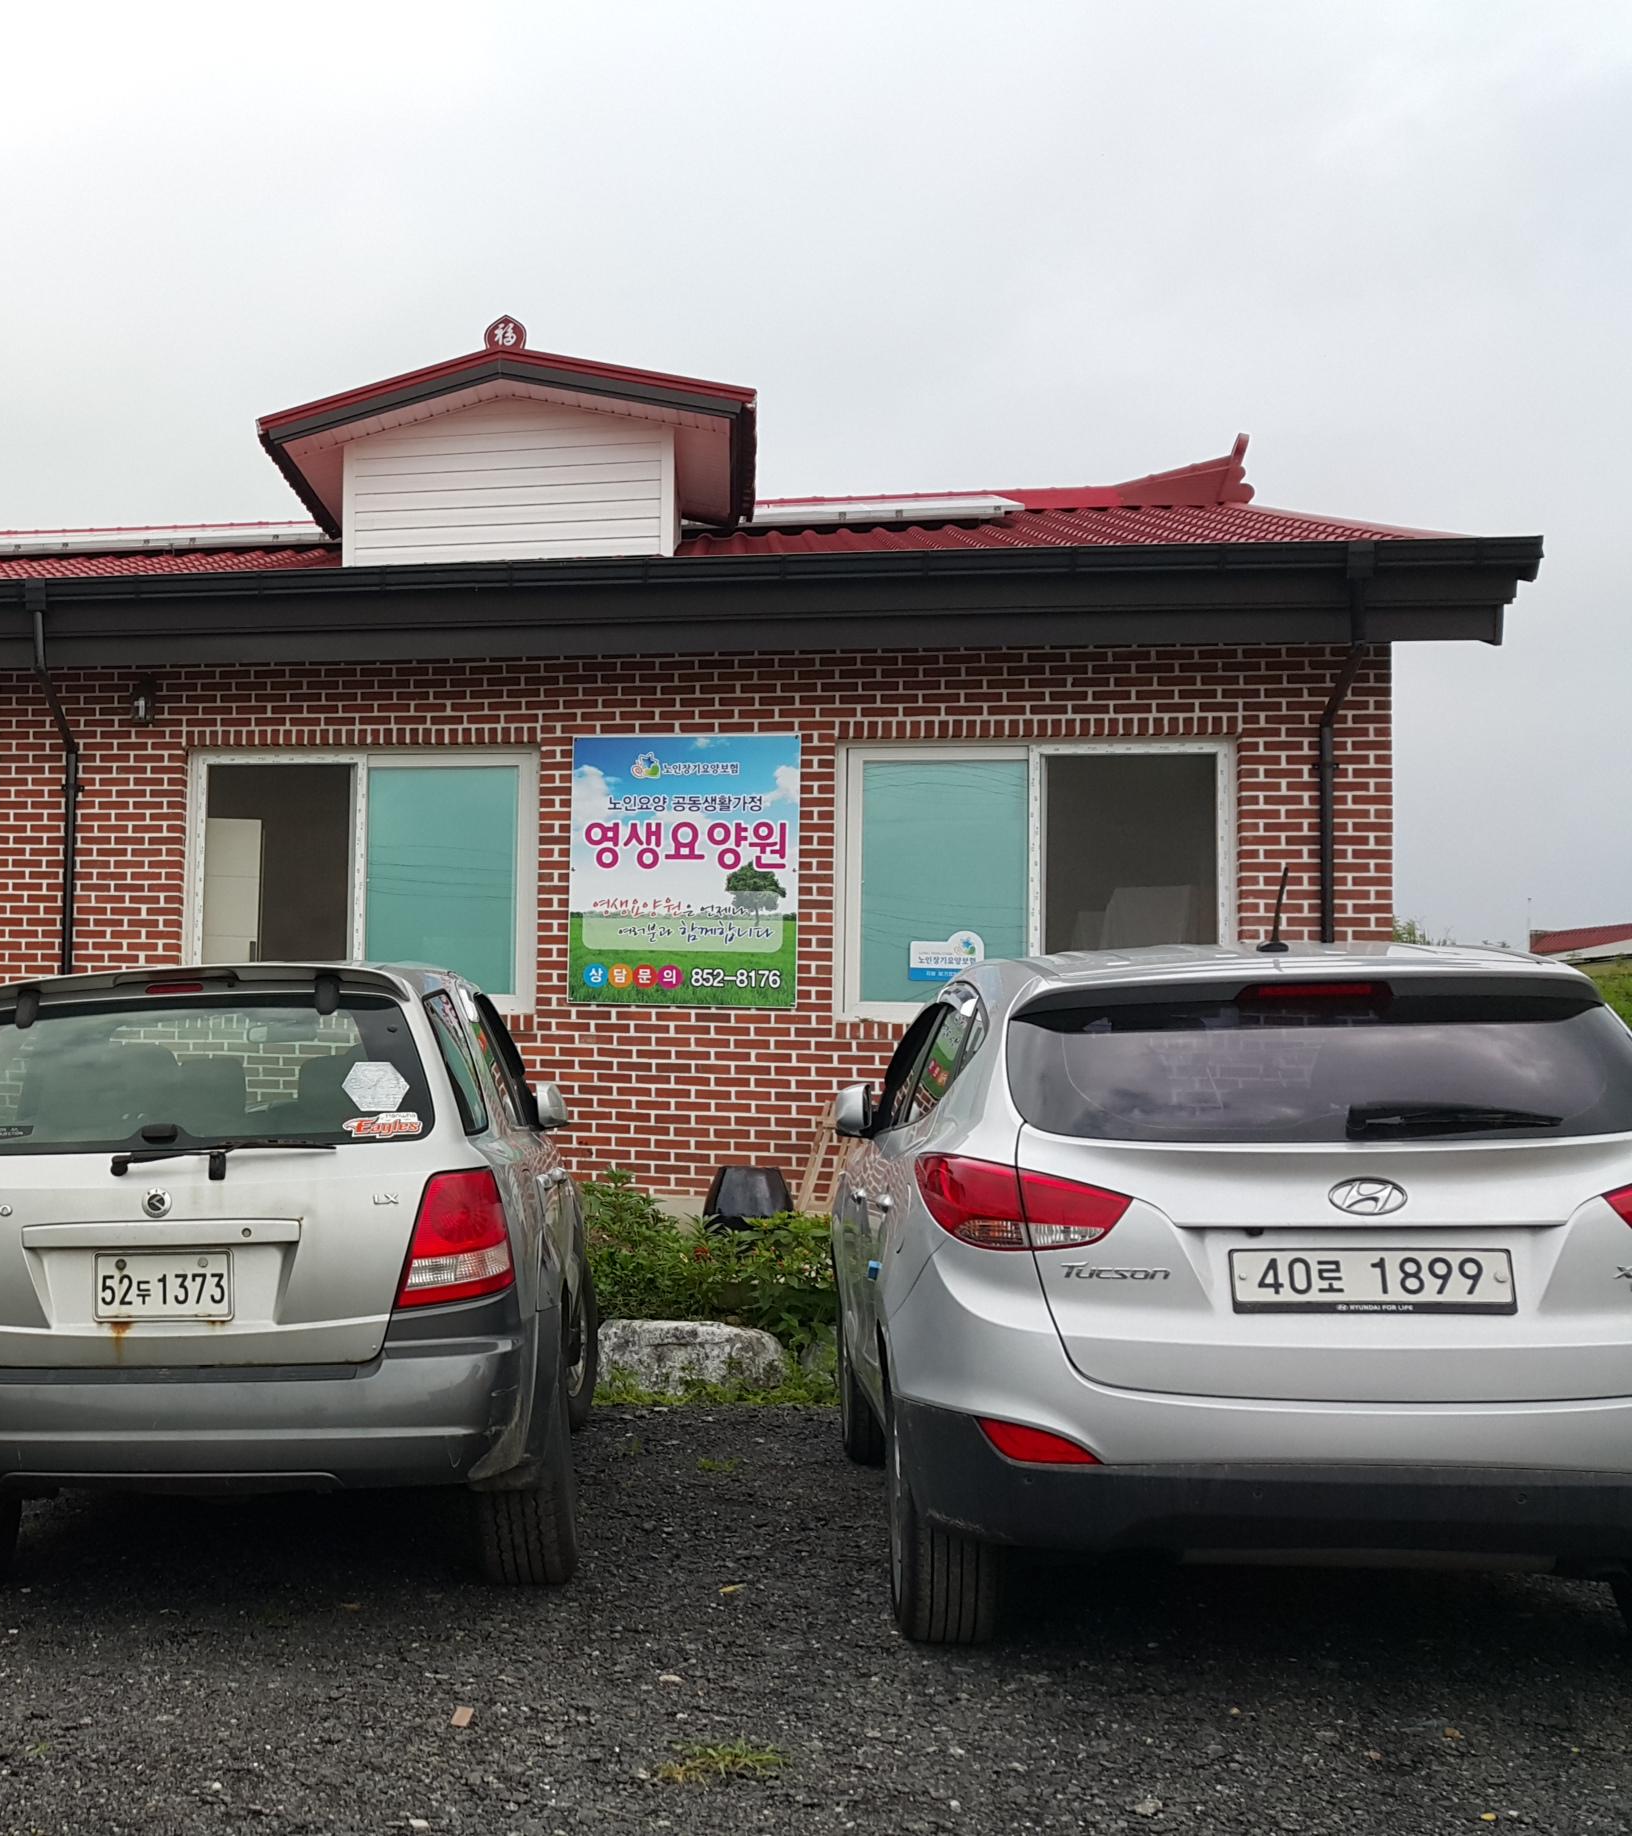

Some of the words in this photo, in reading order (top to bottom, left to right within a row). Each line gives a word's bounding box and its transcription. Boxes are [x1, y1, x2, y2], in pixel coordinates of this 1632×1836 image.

[663, 762, 739, 775] 노인장기요양보험
[608, 795, 667, 811] 노인요양
[672, 795, 763, 812] 공동생활가정
[584, 821, 787, 870] 영생요양원
[592, 897, 695, 916] 영생요양원은
[618, 923, 672, 942] 여러분과
[679, 922, 773, 943] 함께합니다
[588, 968, 677, 984] 상담문의
[690, 969, 781, 989] 852-8176
[356, 1119, 419, 1136] Eagles
[373, 1193, 399, 1205] LX
[1060, 1261, 1171, 1280] Tucson
[1257, 1256, 1345, 1295] 40로
[1370, 1256, 1484, 1296] 1899
[101, 1272, 225, 1306] 52두1373
